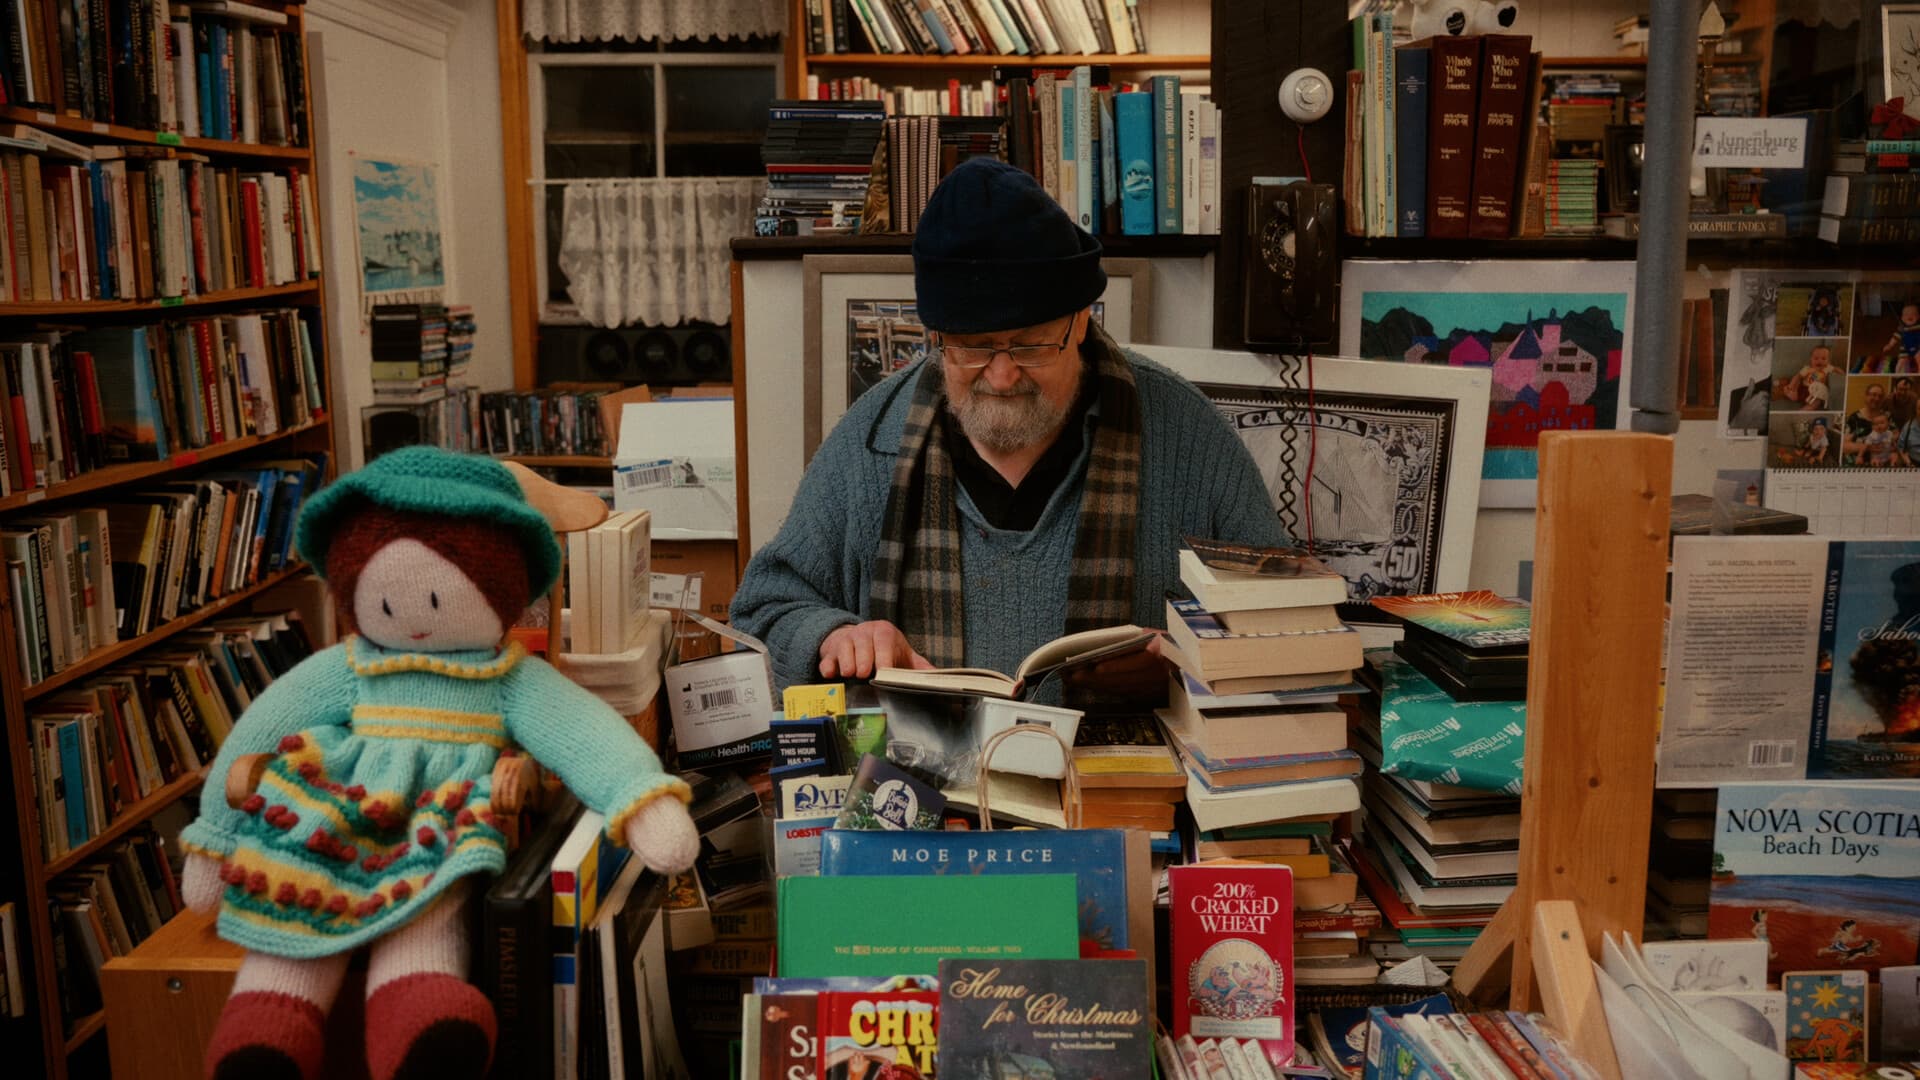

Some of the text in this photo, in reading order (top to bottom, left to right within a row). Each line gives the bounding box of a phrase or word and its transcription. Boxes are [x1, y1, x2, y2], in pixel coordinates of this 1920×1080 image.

[1445, 55, 1472, 66] Who's
[1491, 55, 1520, 67] Who's
[1445, 66, 1466, 78] Who
[1491, 66, 1513, 78] Who
[1737, 221, 1767, 233] INDEX
[1823, 569, 1840, 632] SABOTEUR
[1857, 614, 1920, 642] Sabo
[780, 747, 817, 756] THIS HOUR
[1726, 807, 1920, 838] NOVA SCOTIA
[786, 826, 826, 839] LOBSTE
[891, 848, 1054, 863] MOE PRICE
[1763, 834, 1880, 863] Beach Days
[1213, 882, 1257, 898] 200%
[1190, 896, 1279, 916] CRACKED
[1199, 914, 1272, 935] WHEAT
[948, 967, 1028, 1001] Home
[983, 990, 1142, 1029] for Christmas
[848, 1000, 938, 1046] CHR
[1059, 1031, 1080, 1039] from
[1080, 1031, 1094, 1039] the
[1059, 1041, 1116, 1050] Newfoundland
